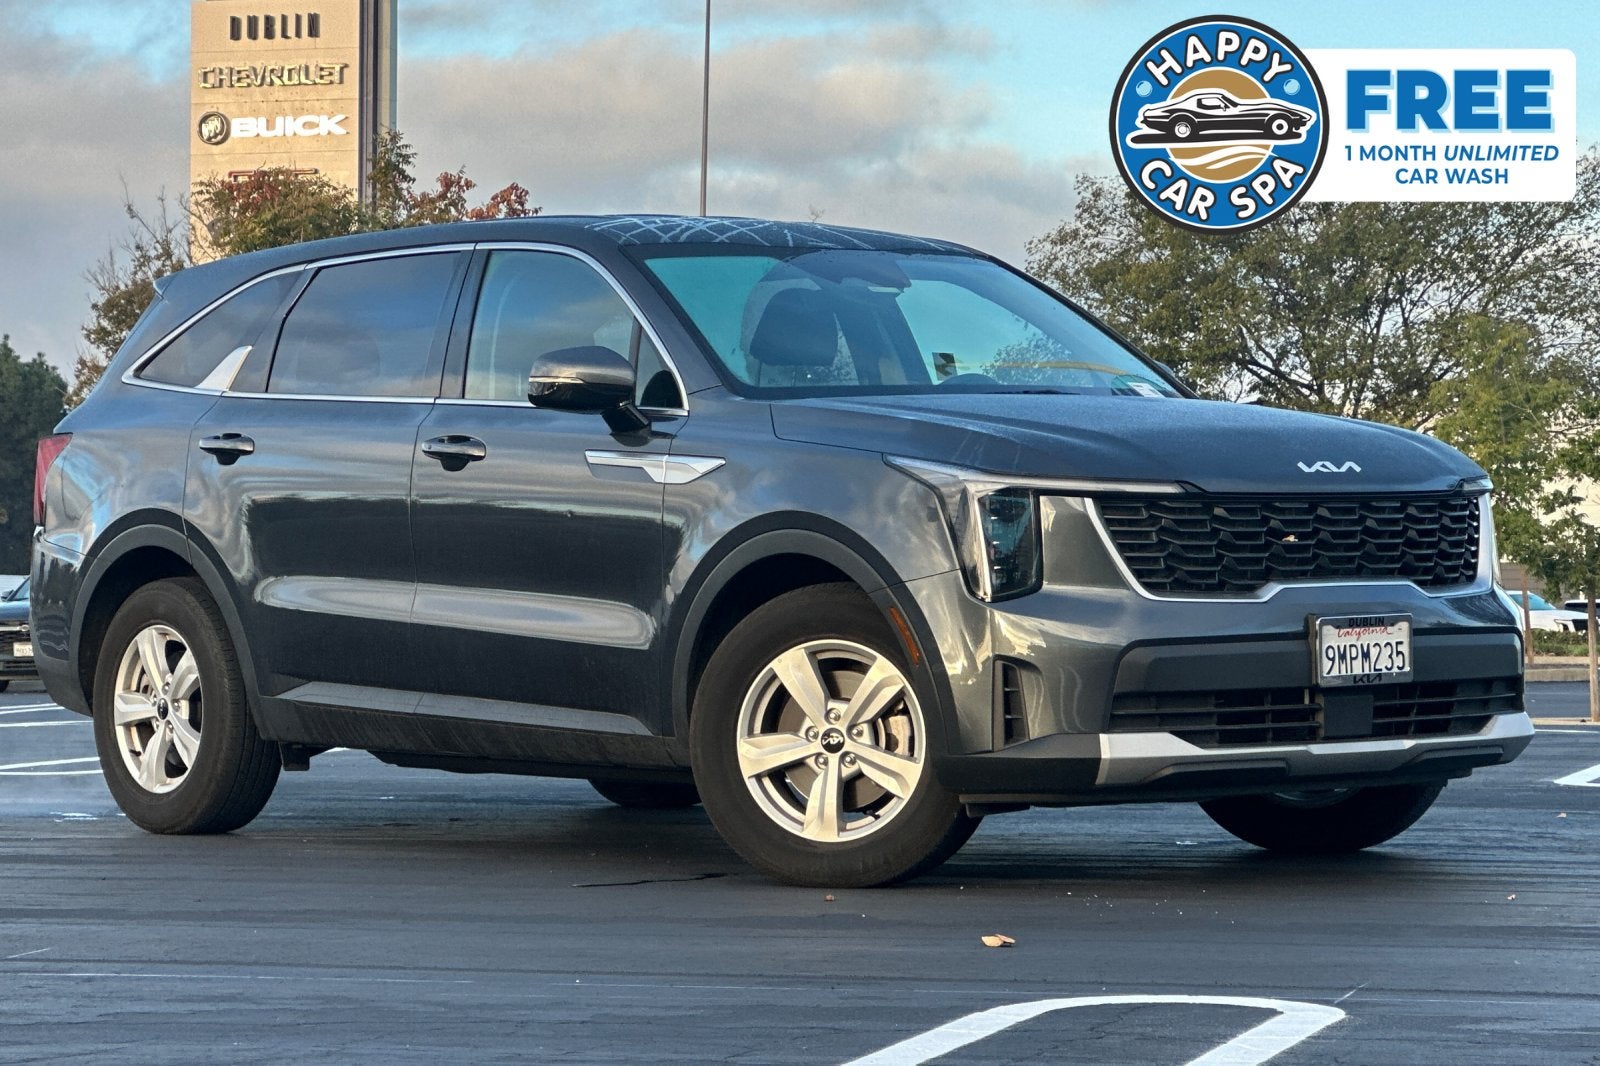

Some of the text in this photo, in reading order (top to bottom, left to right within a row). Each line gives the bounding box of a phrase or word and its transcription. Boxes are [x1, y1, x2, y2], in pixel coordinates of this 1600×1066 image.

[229, 12, 320, 41] DUBLIN
[198, 63, 349, 89] CHEVROLET
[230, 114, 348, 138] BUICK
[1348, 617, 1385, 628] DUBLIN
[1325, 641, 1406, 675] 9MPM235
